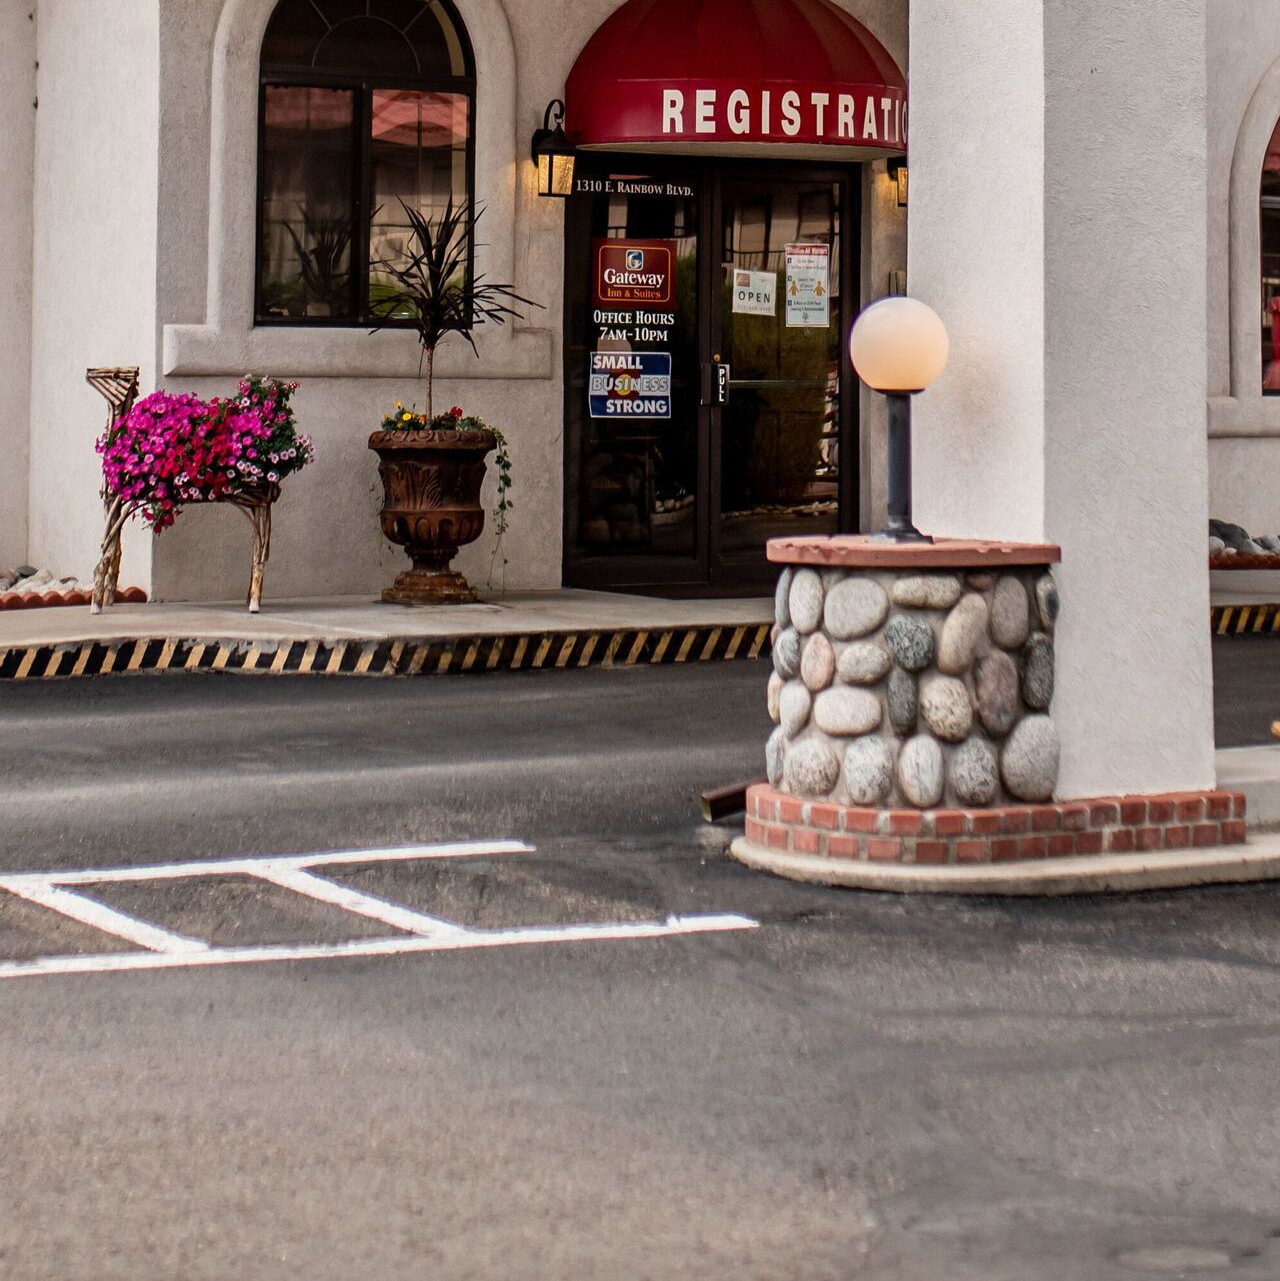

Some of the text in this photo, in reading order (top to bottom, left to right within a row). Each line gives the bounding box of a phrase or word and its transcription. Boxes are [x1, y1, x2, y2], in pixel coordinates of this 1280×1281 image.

[576, 179, 602, 192] 1310
[605, 181, 614, 193] E.
[603, 268, 665, 288] Gateway
[607, 287, 661, 299] Inn & Suites
[738, 290, 771, 303] OPEN
[592, 355, 643, 370] SMALL
[591, 376, 669, 392] BUSINESS
[606, 399, 667, 413] STRONG
